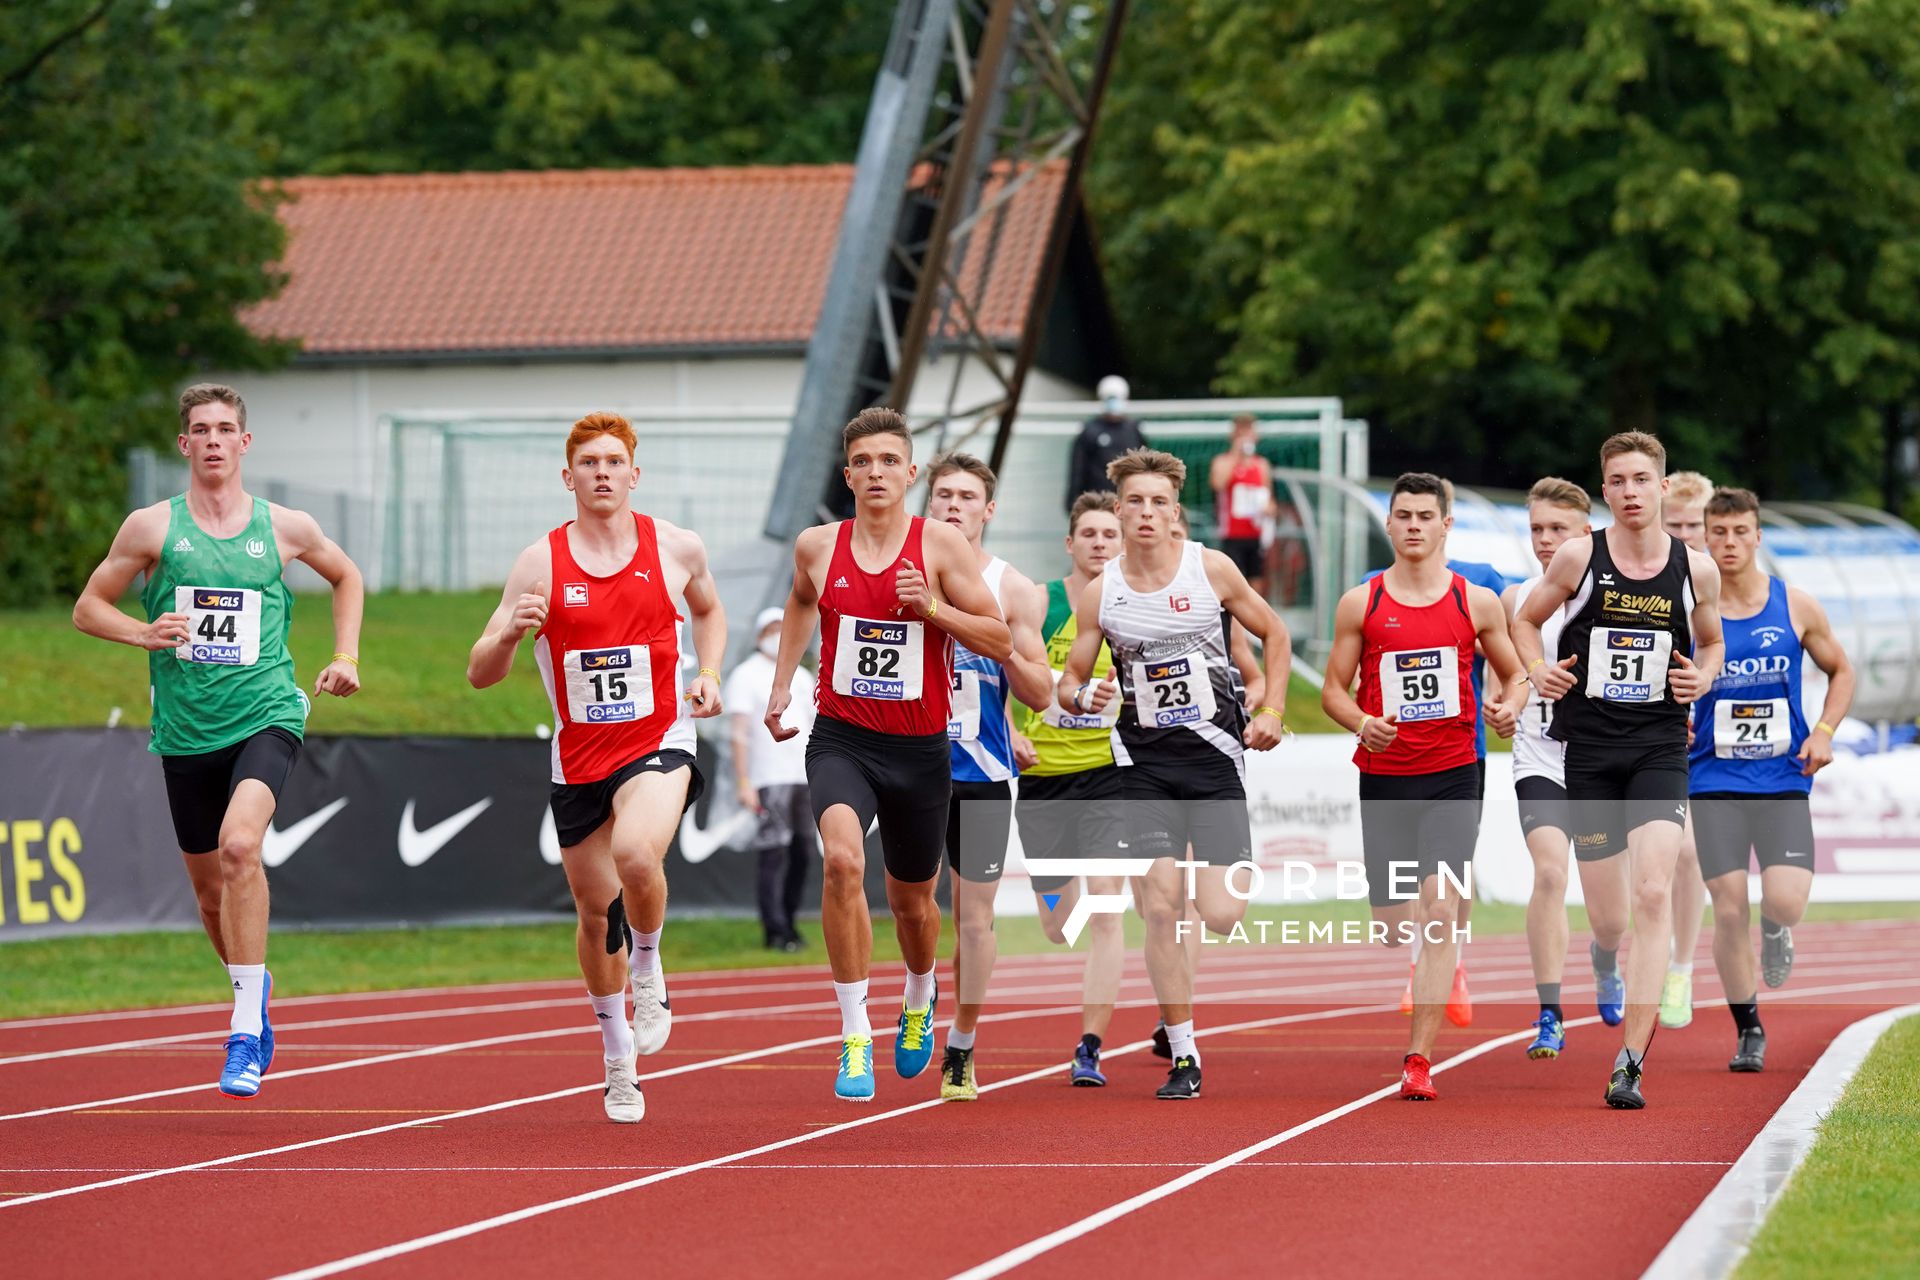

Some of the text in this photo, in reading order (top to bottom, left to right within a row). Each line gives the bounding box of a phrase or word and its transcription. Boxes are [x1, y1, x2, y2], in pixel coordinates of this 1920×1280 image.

[219, 597, 240, 608] GLS
[197, 614, 237, 643] 44
[881, 630, 903, 641] GLS
[1632, 637, 1651, 648] GLS
[211, 648, 239, 658] PLAN
[607, 653, 627, 666] GLS
[857, 646, 900, 679] 82
[1420, 655, 1438, 667] GLS
[1168, 662, 1187, 675] GLS
[1610, 655, 1645, 682] 51
[589, 672, 628, 702] 15
[872, 683, 901, 693] PLAN
[1402, 673, 1439, 701] 59
[1622, 686, 1649, 695] PLAN
[1154, 680, 1191, 708] 23
[605, 705, 633, 716] PLAN
[1173, 706, 1198, 720] PLAN
[1418, 703, 1444, 713] PLAN
[1753, 706, 1772, 717] GLS
[1736, 723, 1768, 743] 24
